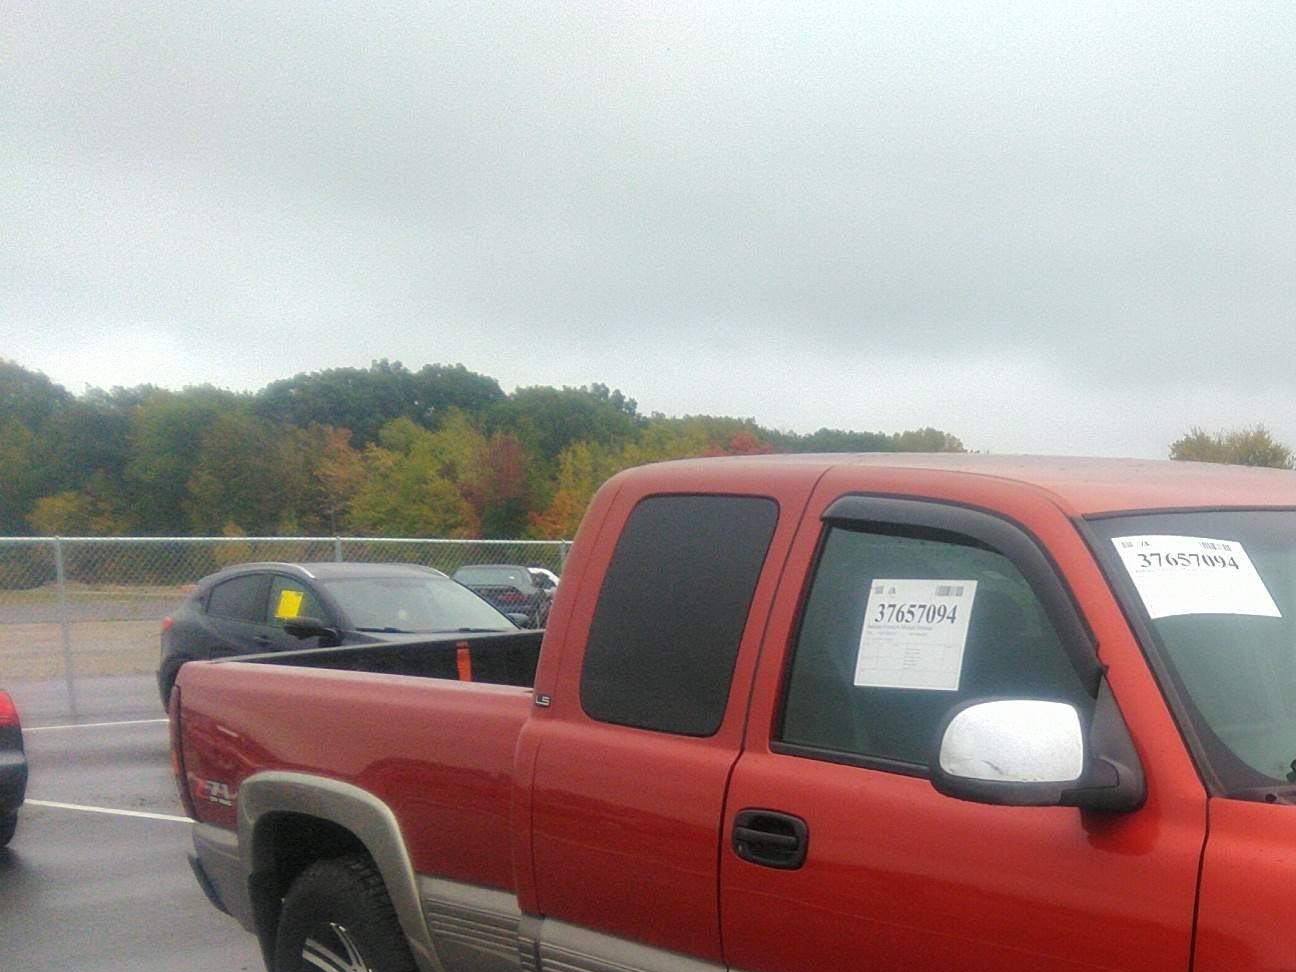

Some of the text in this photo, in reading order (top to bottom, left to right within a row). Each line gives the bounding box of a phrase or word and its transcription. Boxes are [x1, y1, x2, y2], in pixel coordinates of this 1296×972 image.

[1137, 552, 1241, 570] 37657094
[874, 603, 958, 625] 37657094
[535, 694, 551, 707] LS
